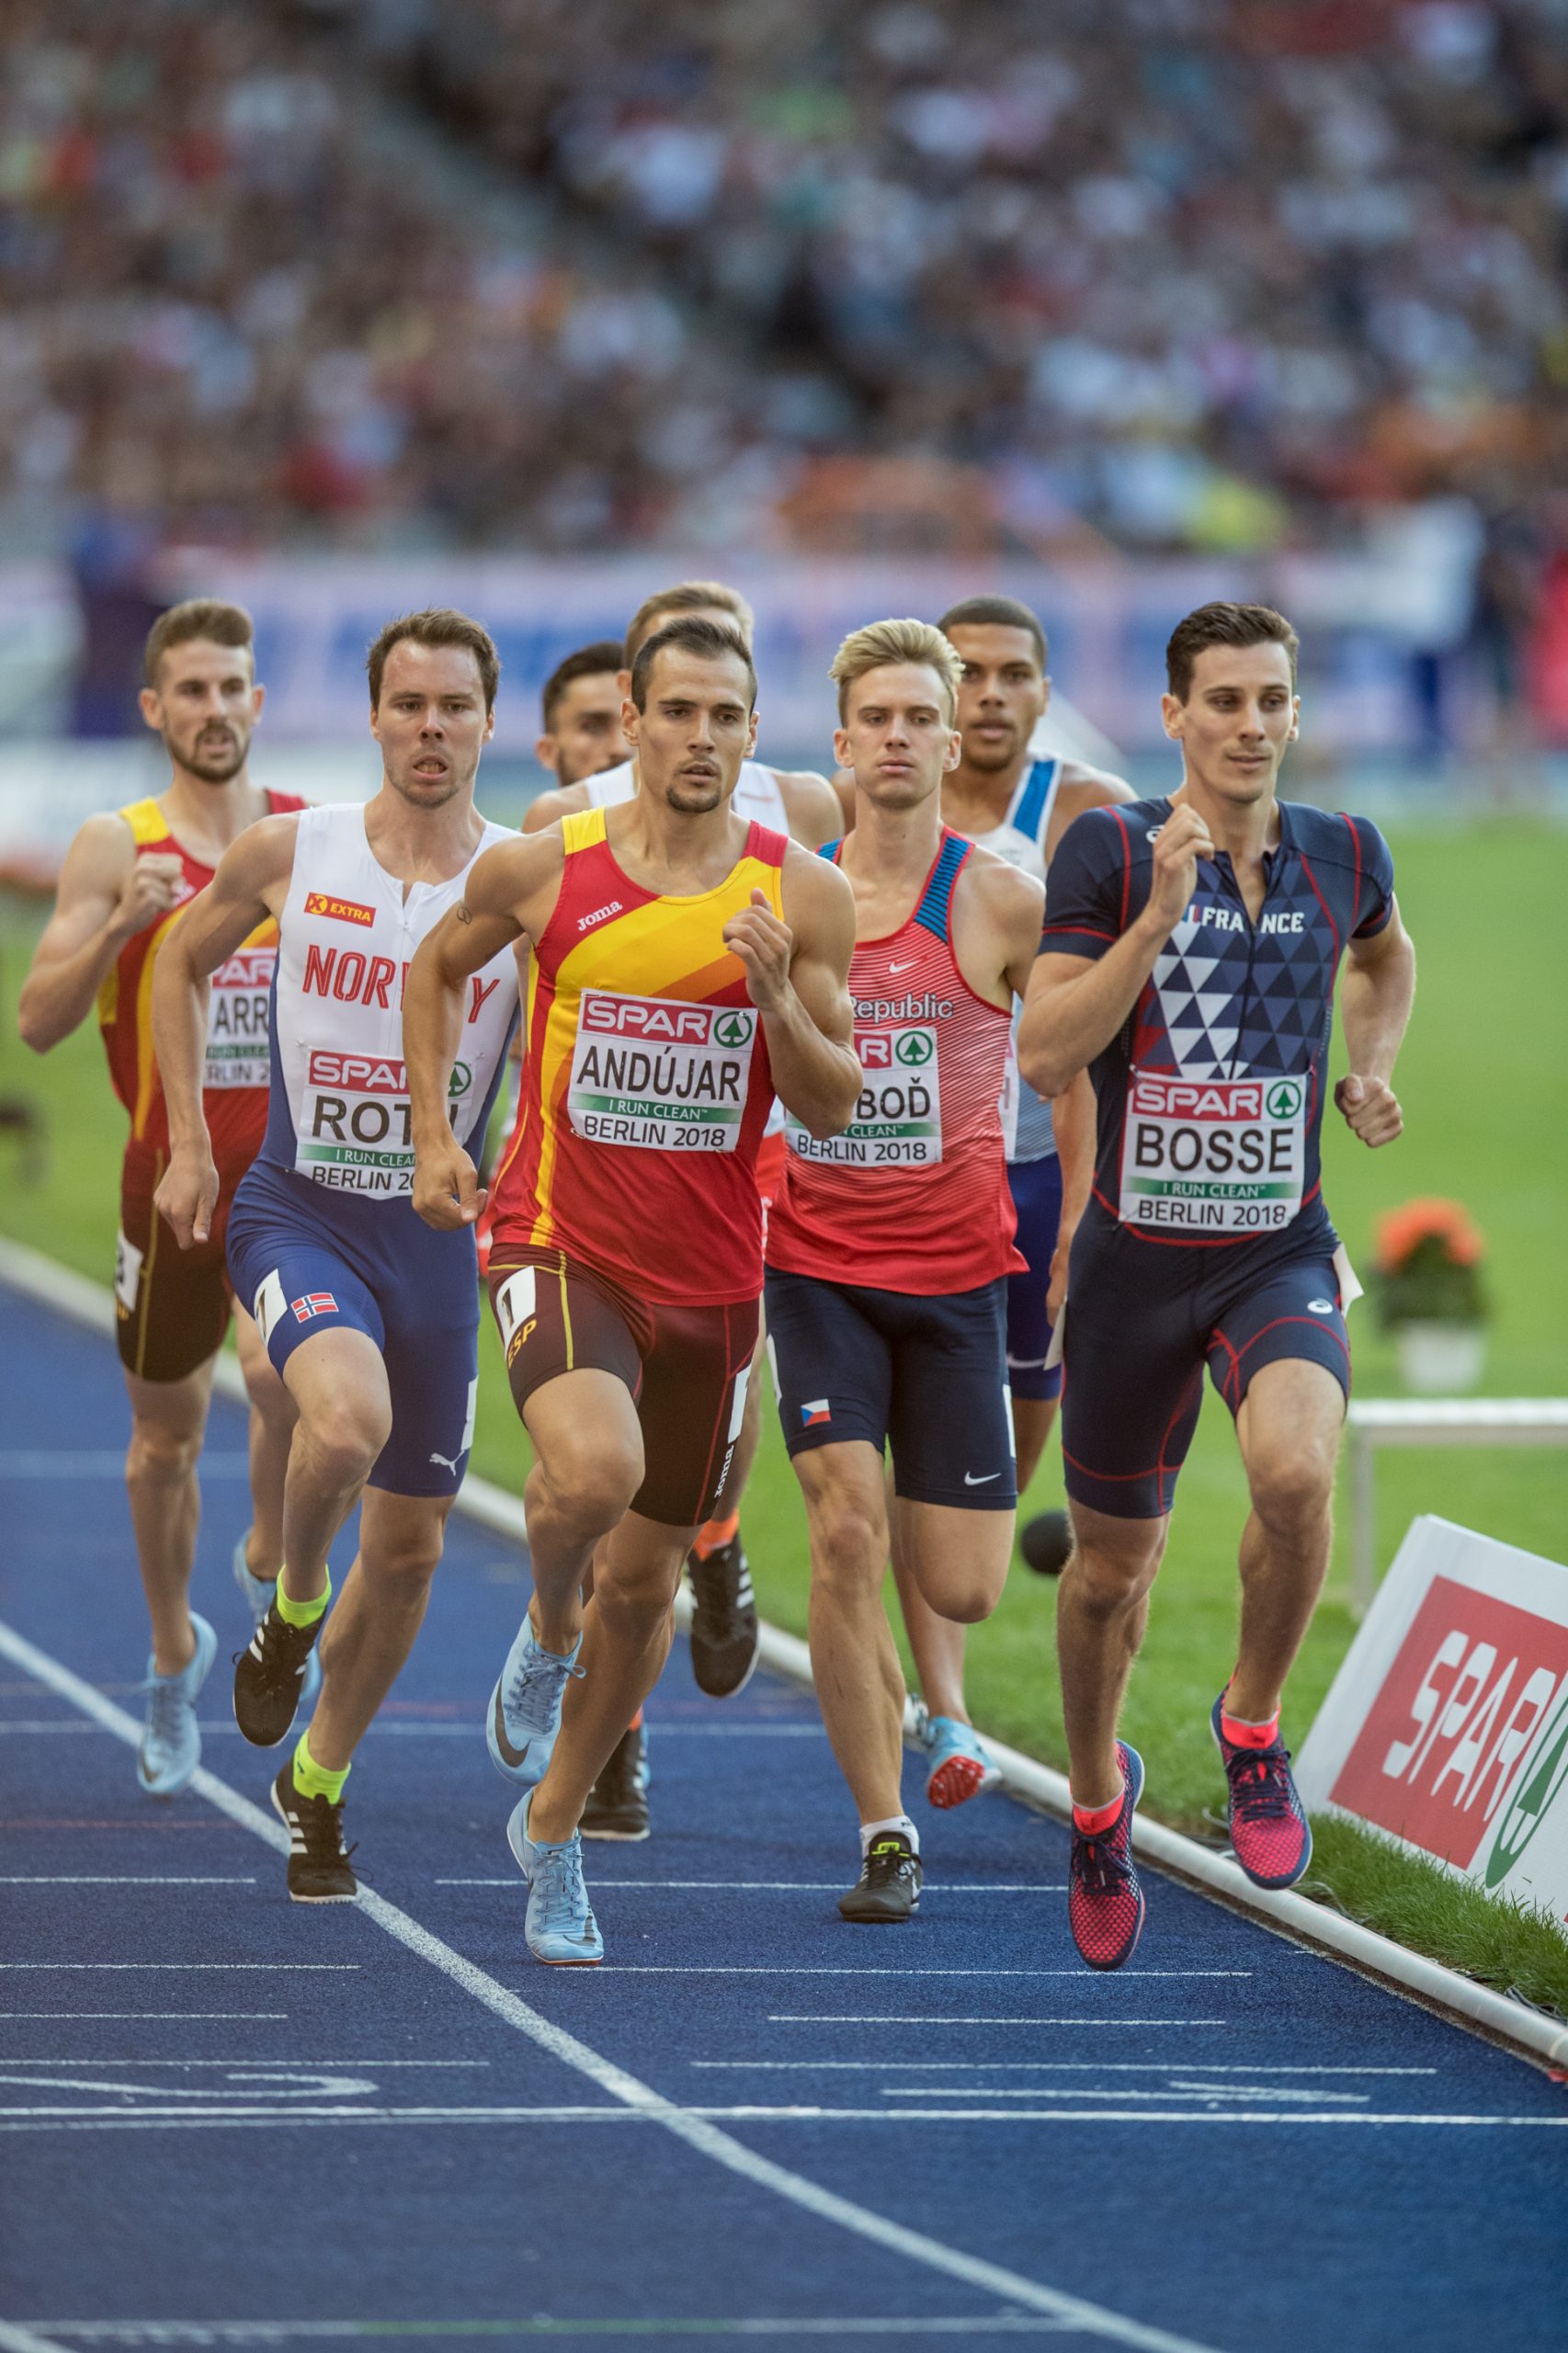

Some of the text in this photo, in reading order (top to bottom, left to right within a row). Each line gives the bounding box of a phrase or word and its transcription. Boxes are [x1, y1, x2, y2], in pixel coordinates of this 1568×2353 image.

[330, 903, 371, 922] EXTRA
[1201, 906, 1305, 934] FRANCE
[302, 944, 500, 1024] NORY
[587, 1000, 708, 1040] SPAR
[576, 1045, 741, 1102] ANDÚJAR
[618, 1101, 649, 1116] RUN
[1136, 1083, 1260, 1118] SPAR
[312, 1095, 458, 1146] ROT
[585, 1115, 726, 1147] BERLIN 2018
[345, 1150, 375, 1165] RUN
[798, 1134, 926, 1162] BERLIN 2018
[1135, 1123, 1294, 1175] BOSSE
[312, 1165, 392, 1190] BERLIN
[1172, 1183, 1205, 1197] RUN
[1139, 1199, 1287, 1226] BERLIN 2018
[1382, 1630, 1556, 1822] SPAR
